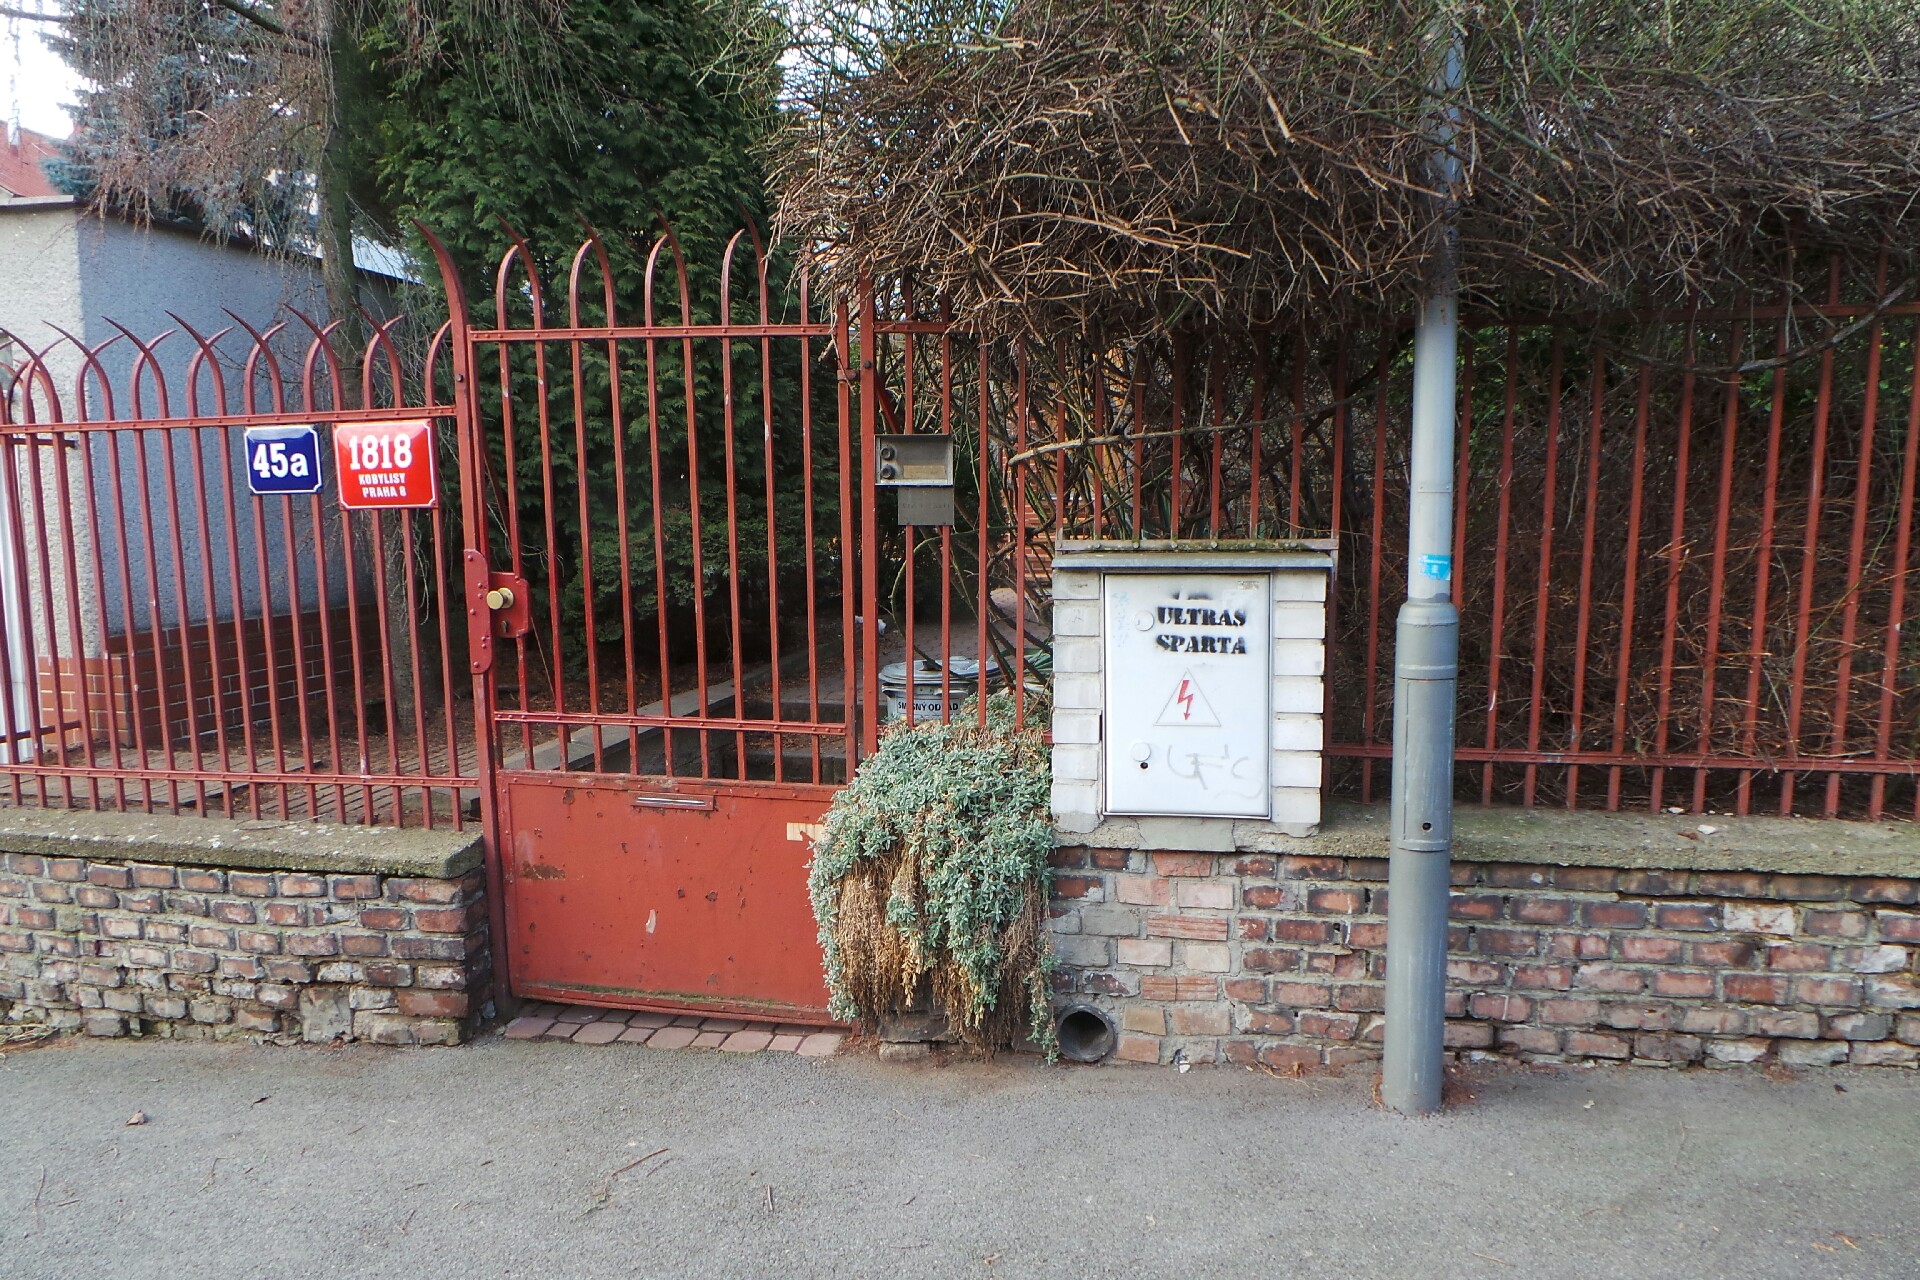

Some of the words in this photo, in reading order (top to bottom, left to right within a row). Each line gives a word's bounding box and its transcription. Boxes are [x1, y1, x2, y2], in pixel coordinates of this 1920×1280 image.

[253, 442, 308, 478] 45a
[350, 433, 412, 470] 1818
[358, 472, 406, 485] KOBYLISY
[362, 486, 397, 498] PRAHA
[399, 487, 407, 497] 8
[1157, 606, 1247, 627] ULTRAS
[1156, 634, 1247, 654] SPARTA
[928, 703, 959, 711] ODAD
